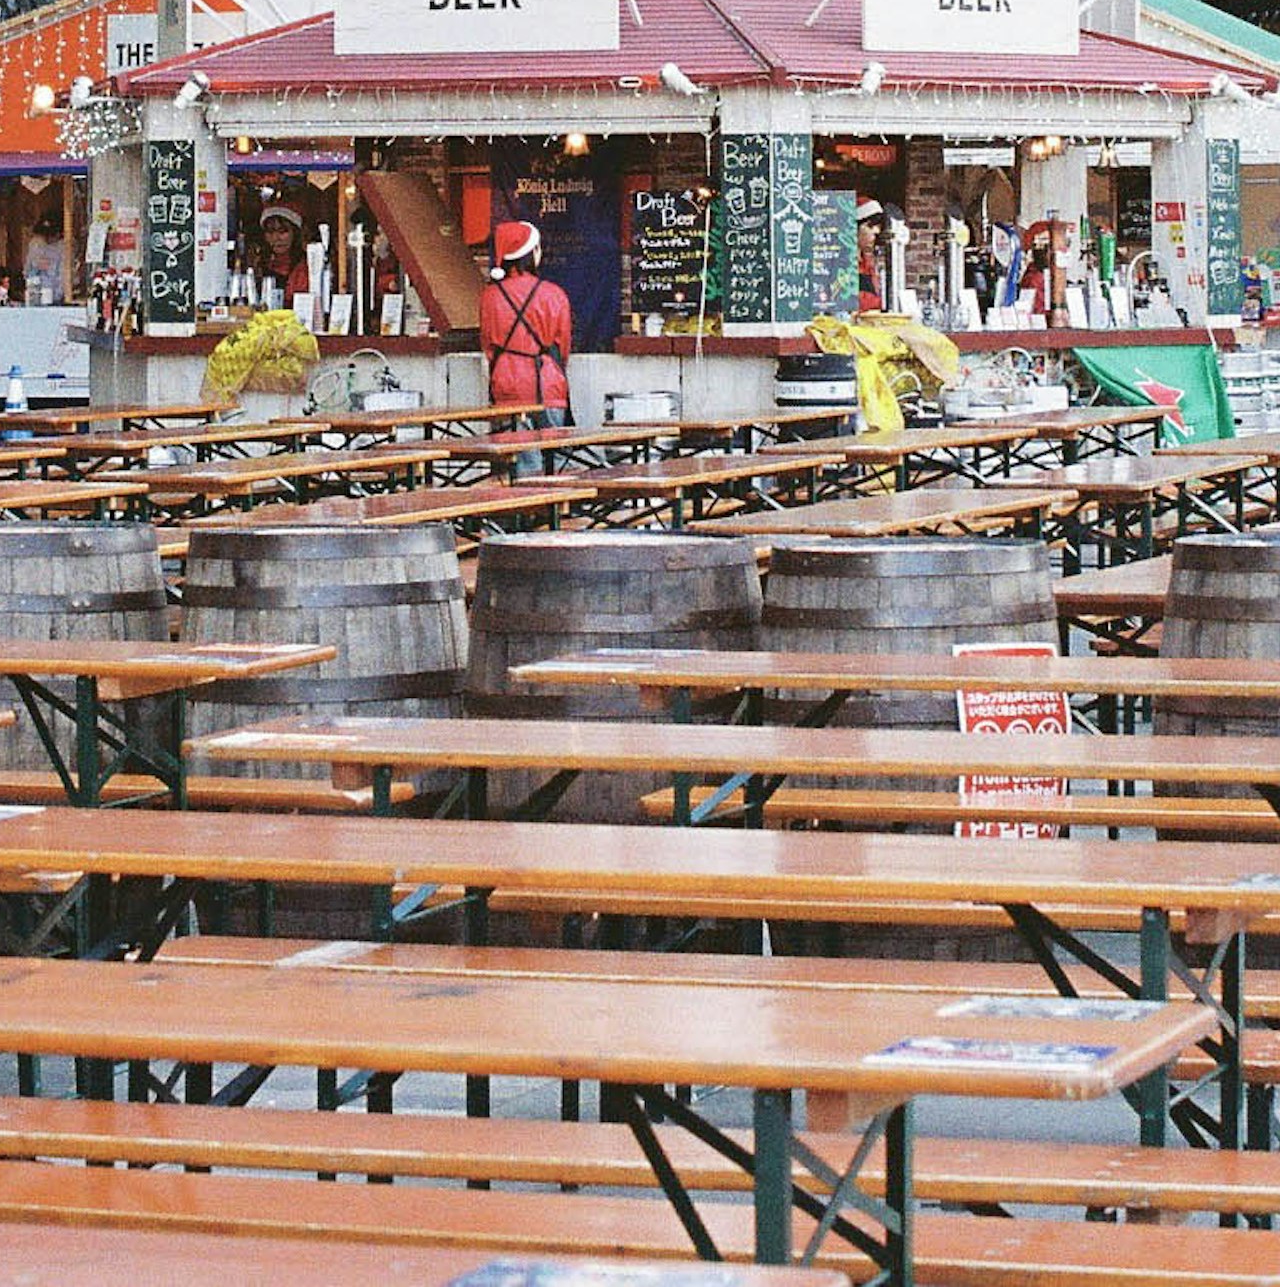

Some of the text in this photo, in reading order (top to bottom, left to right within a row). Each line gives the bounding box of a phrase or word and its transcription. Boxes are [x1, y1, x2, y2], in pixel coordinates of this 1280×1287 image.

[116, 43, 154, 66] THE
[723, 141, 763, 169] Beer
[158, 171, 187, 191] Beer
[778, 160, 804, 184] Beer
[637, 191, 675, 211] Draft
[662, 207, 696, 228] Beer
[151, 271, 188, 298] Beer
